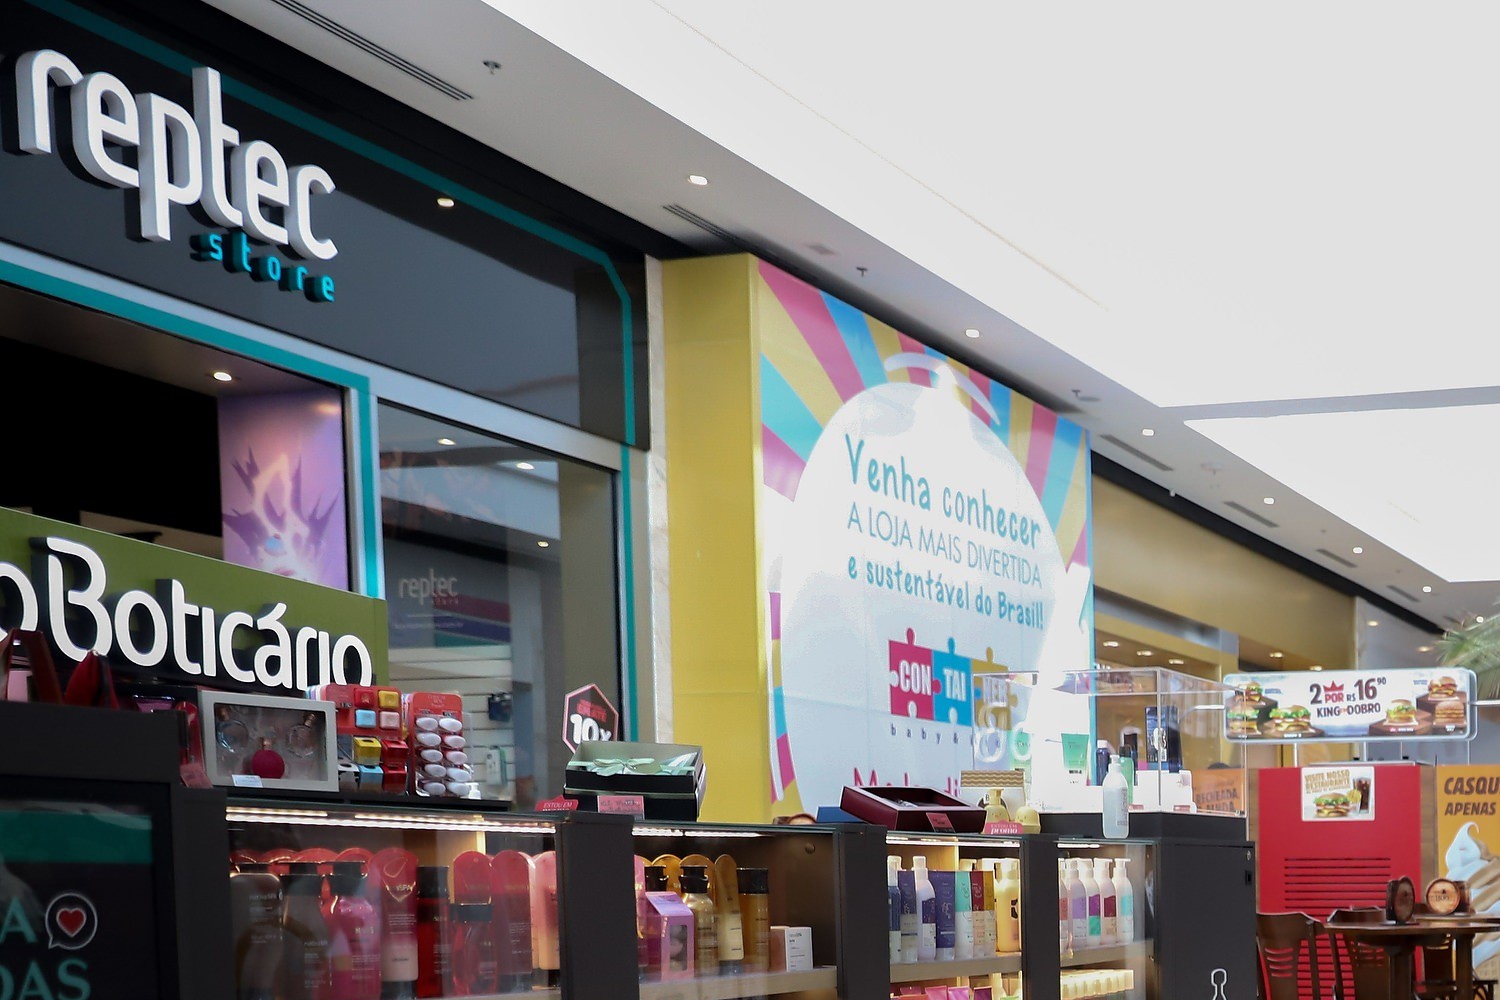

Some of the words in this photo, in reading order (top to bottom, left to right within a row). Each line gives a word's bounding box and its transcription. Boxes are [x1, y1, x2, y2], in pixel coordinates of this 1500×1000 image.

[15, 48, 338, 260] reptec
[203, 229, 335, 302] store
[845, 433, 931, 511] Venha
[942, 488, 1041, 550] conhecer
[847, 501, 863, 534] A
[868, 506, 912, 549] LOJA
[918, 526, 962, 564] MAIS
[967, 540, 1042, 589] DIVERTIDA
[399, 568, 458, 605] reptec
[848, 555, 858, 580] e
[866, 560, 970, 611] sustentável
[974, 594, 992, 616] do
[997, 591, 1044, 630] Brasil!
[1309, 683, 1322, 705] 2
[1324, 693, 1344, 704] POR
[1317, 705, 1340, 718] KING
[1347, 703, 1381, 715] DOBRO
[1445, 802, 1496, 816] APENAS
